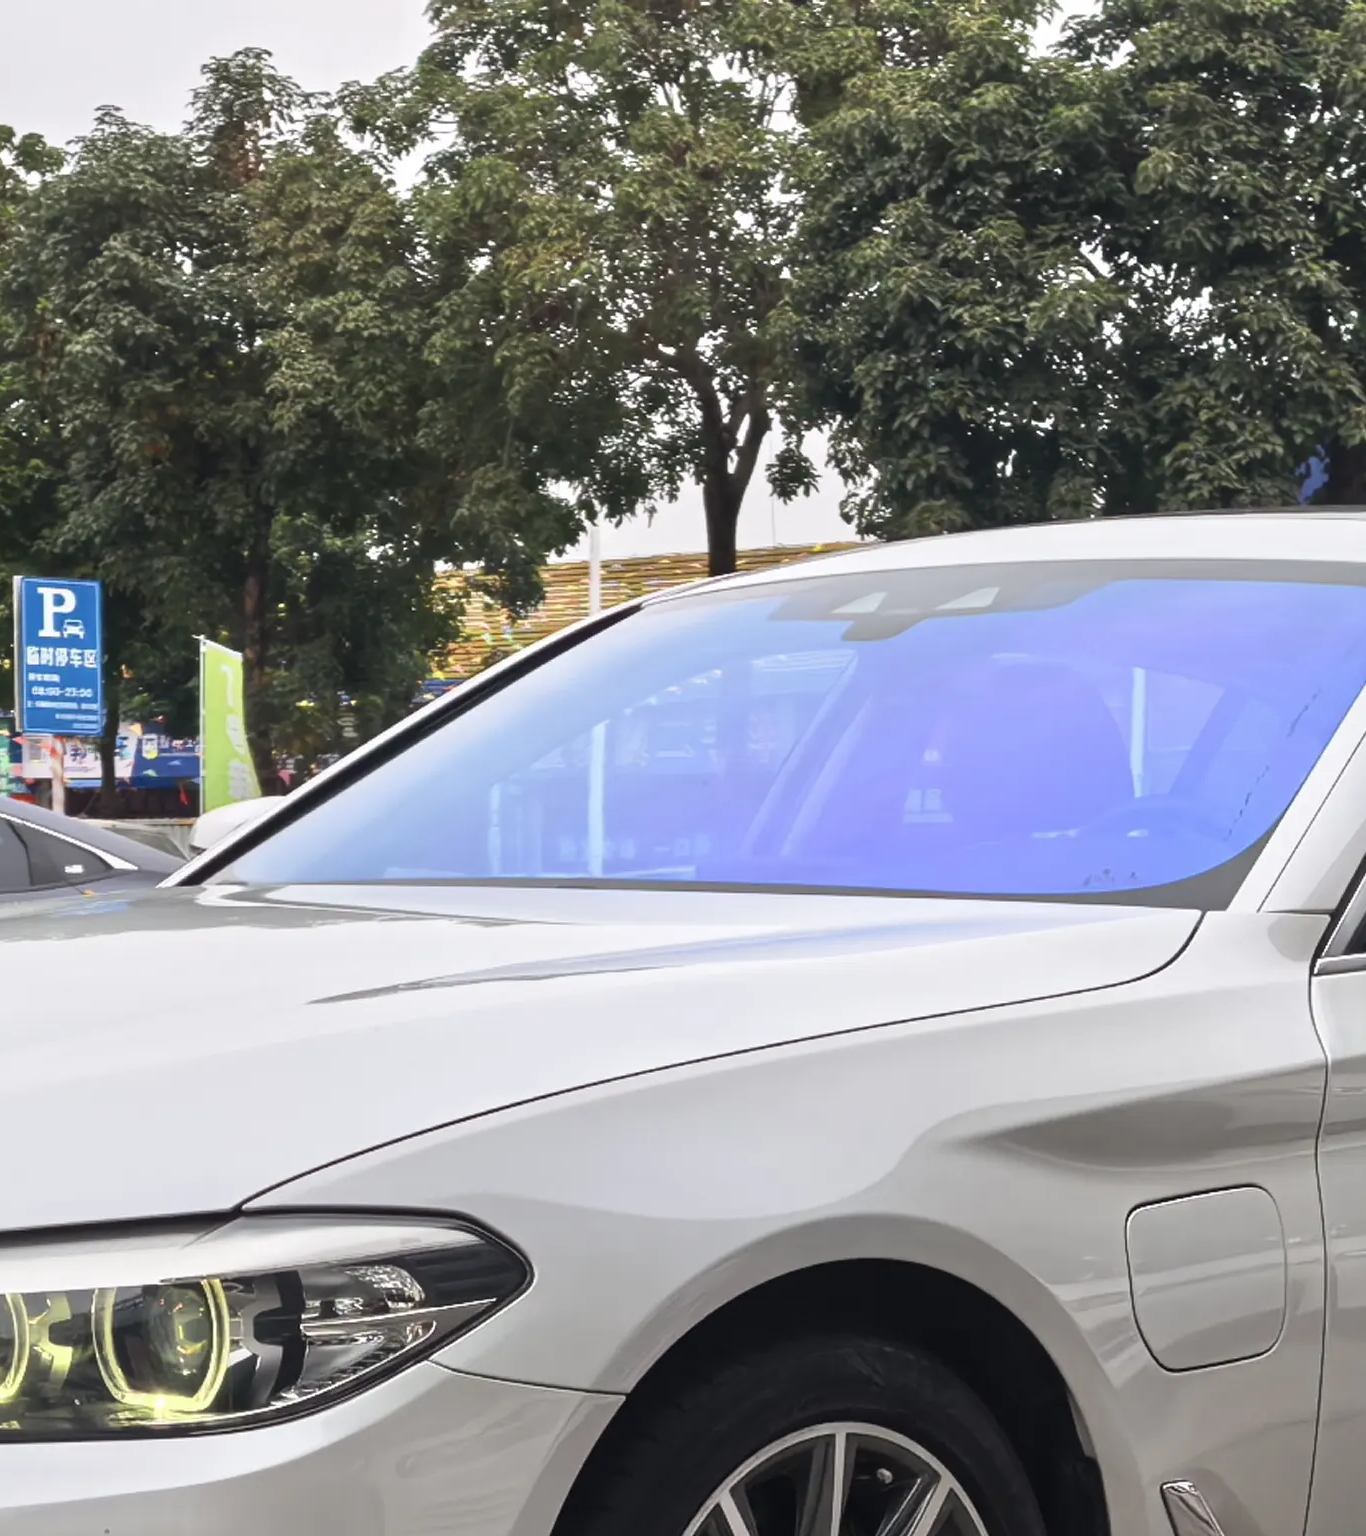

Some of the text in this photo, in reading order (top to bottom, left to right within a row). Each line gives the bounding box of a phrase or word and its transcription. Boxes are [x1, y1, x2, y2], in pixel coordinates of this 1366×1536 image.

[36, 586, 77, 638] P
[26, 645, 98, 669] 临时停车区
